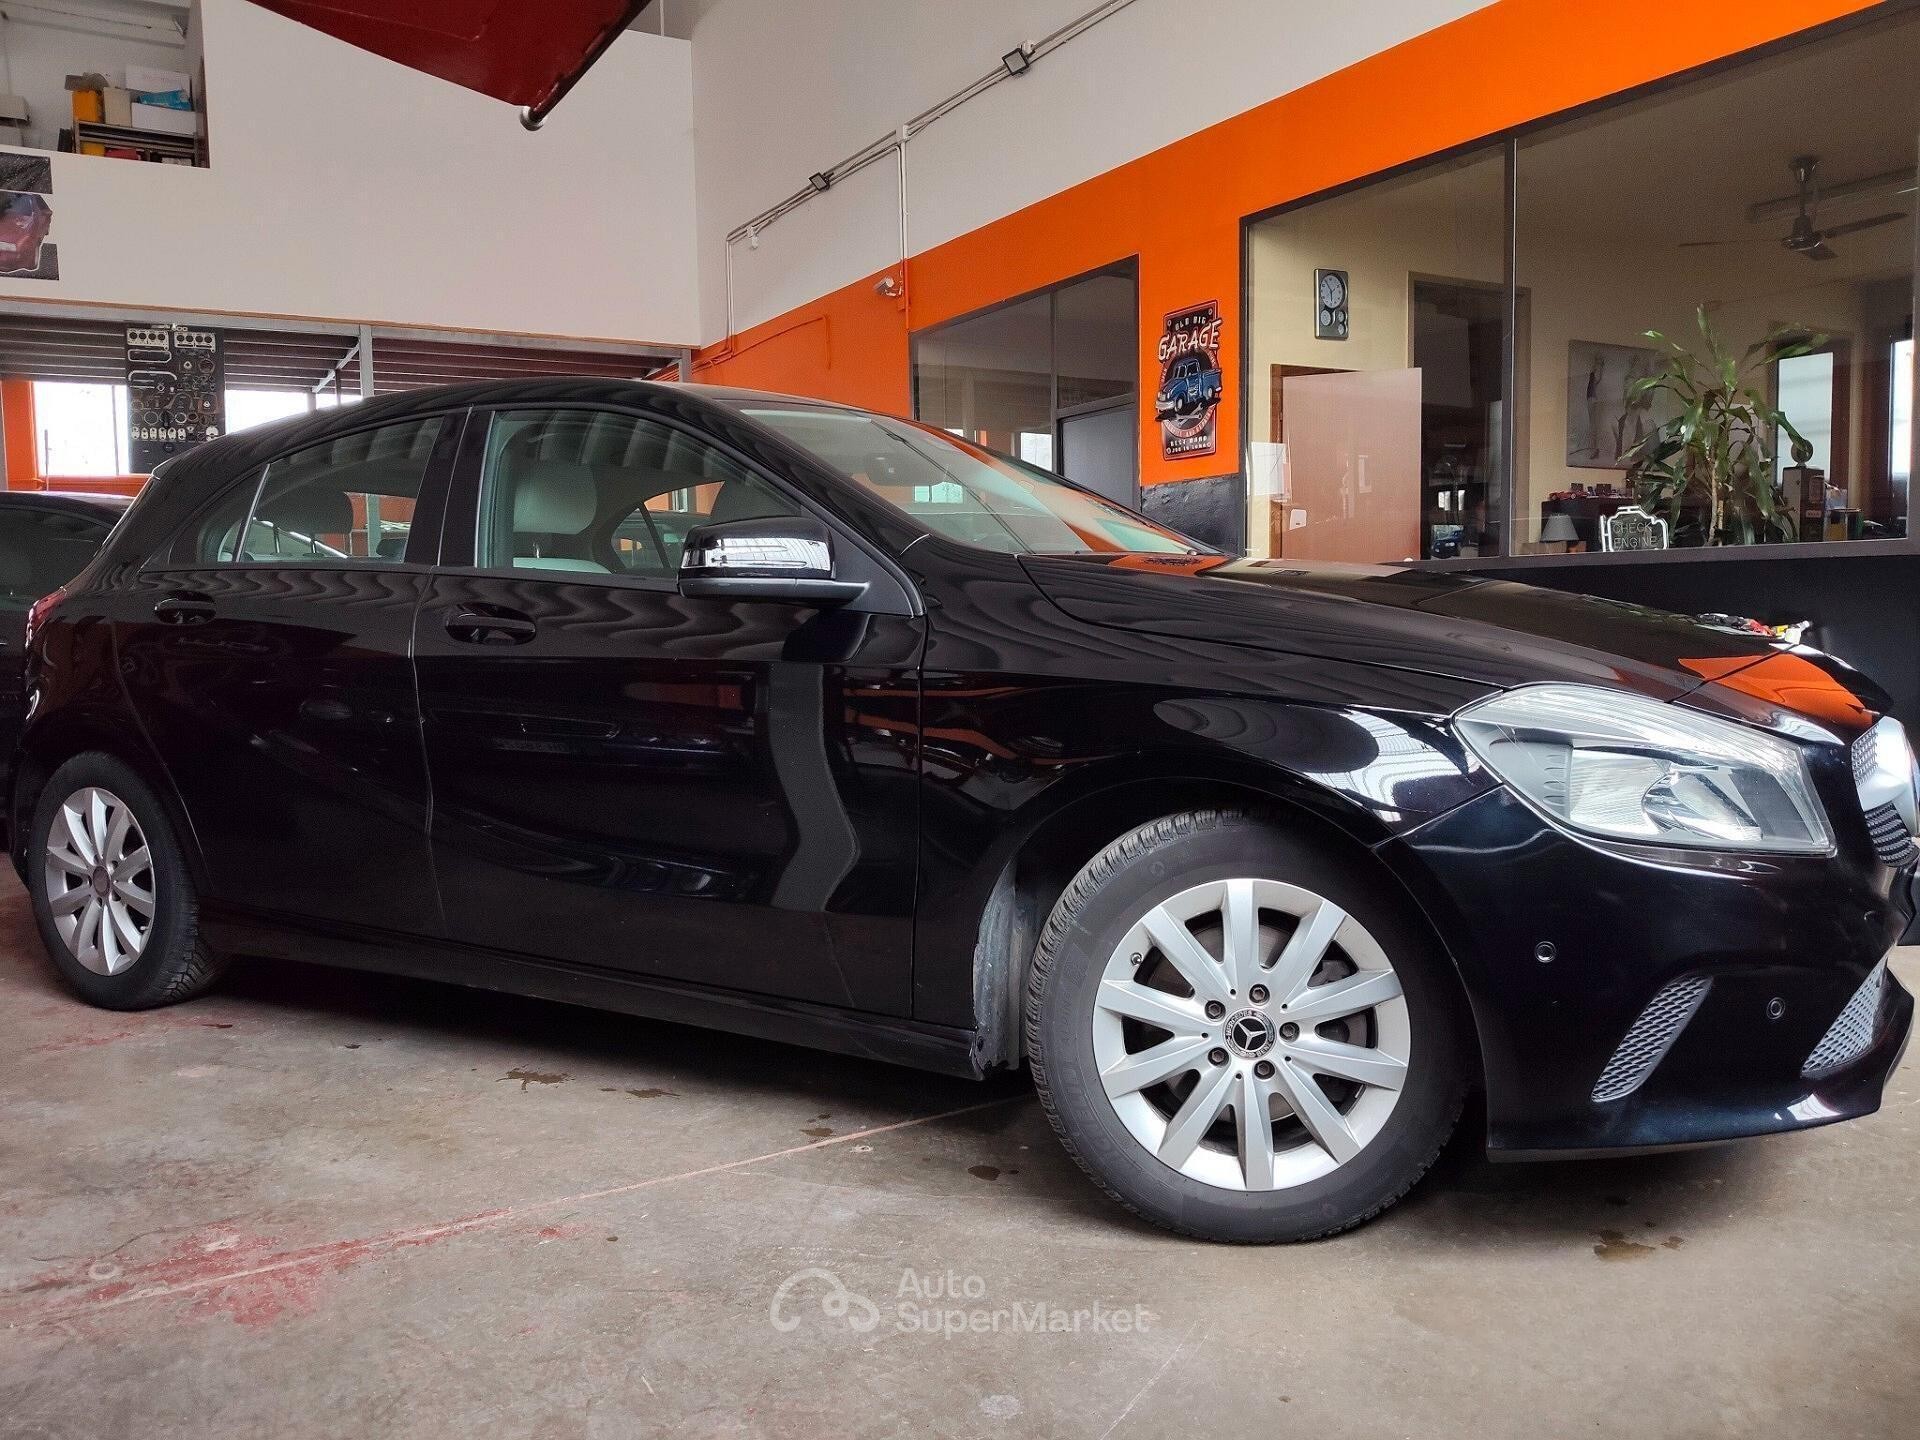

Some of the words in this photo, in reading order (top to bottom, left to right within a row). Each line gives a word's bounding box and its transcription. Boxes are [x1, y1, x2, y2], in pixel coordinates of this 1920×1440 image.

[1158, 319, 1222, 361] GARAGE
[1613, 521, 1653, 534] CHECK
[1614, 535, 1658, 548] ENGINE
